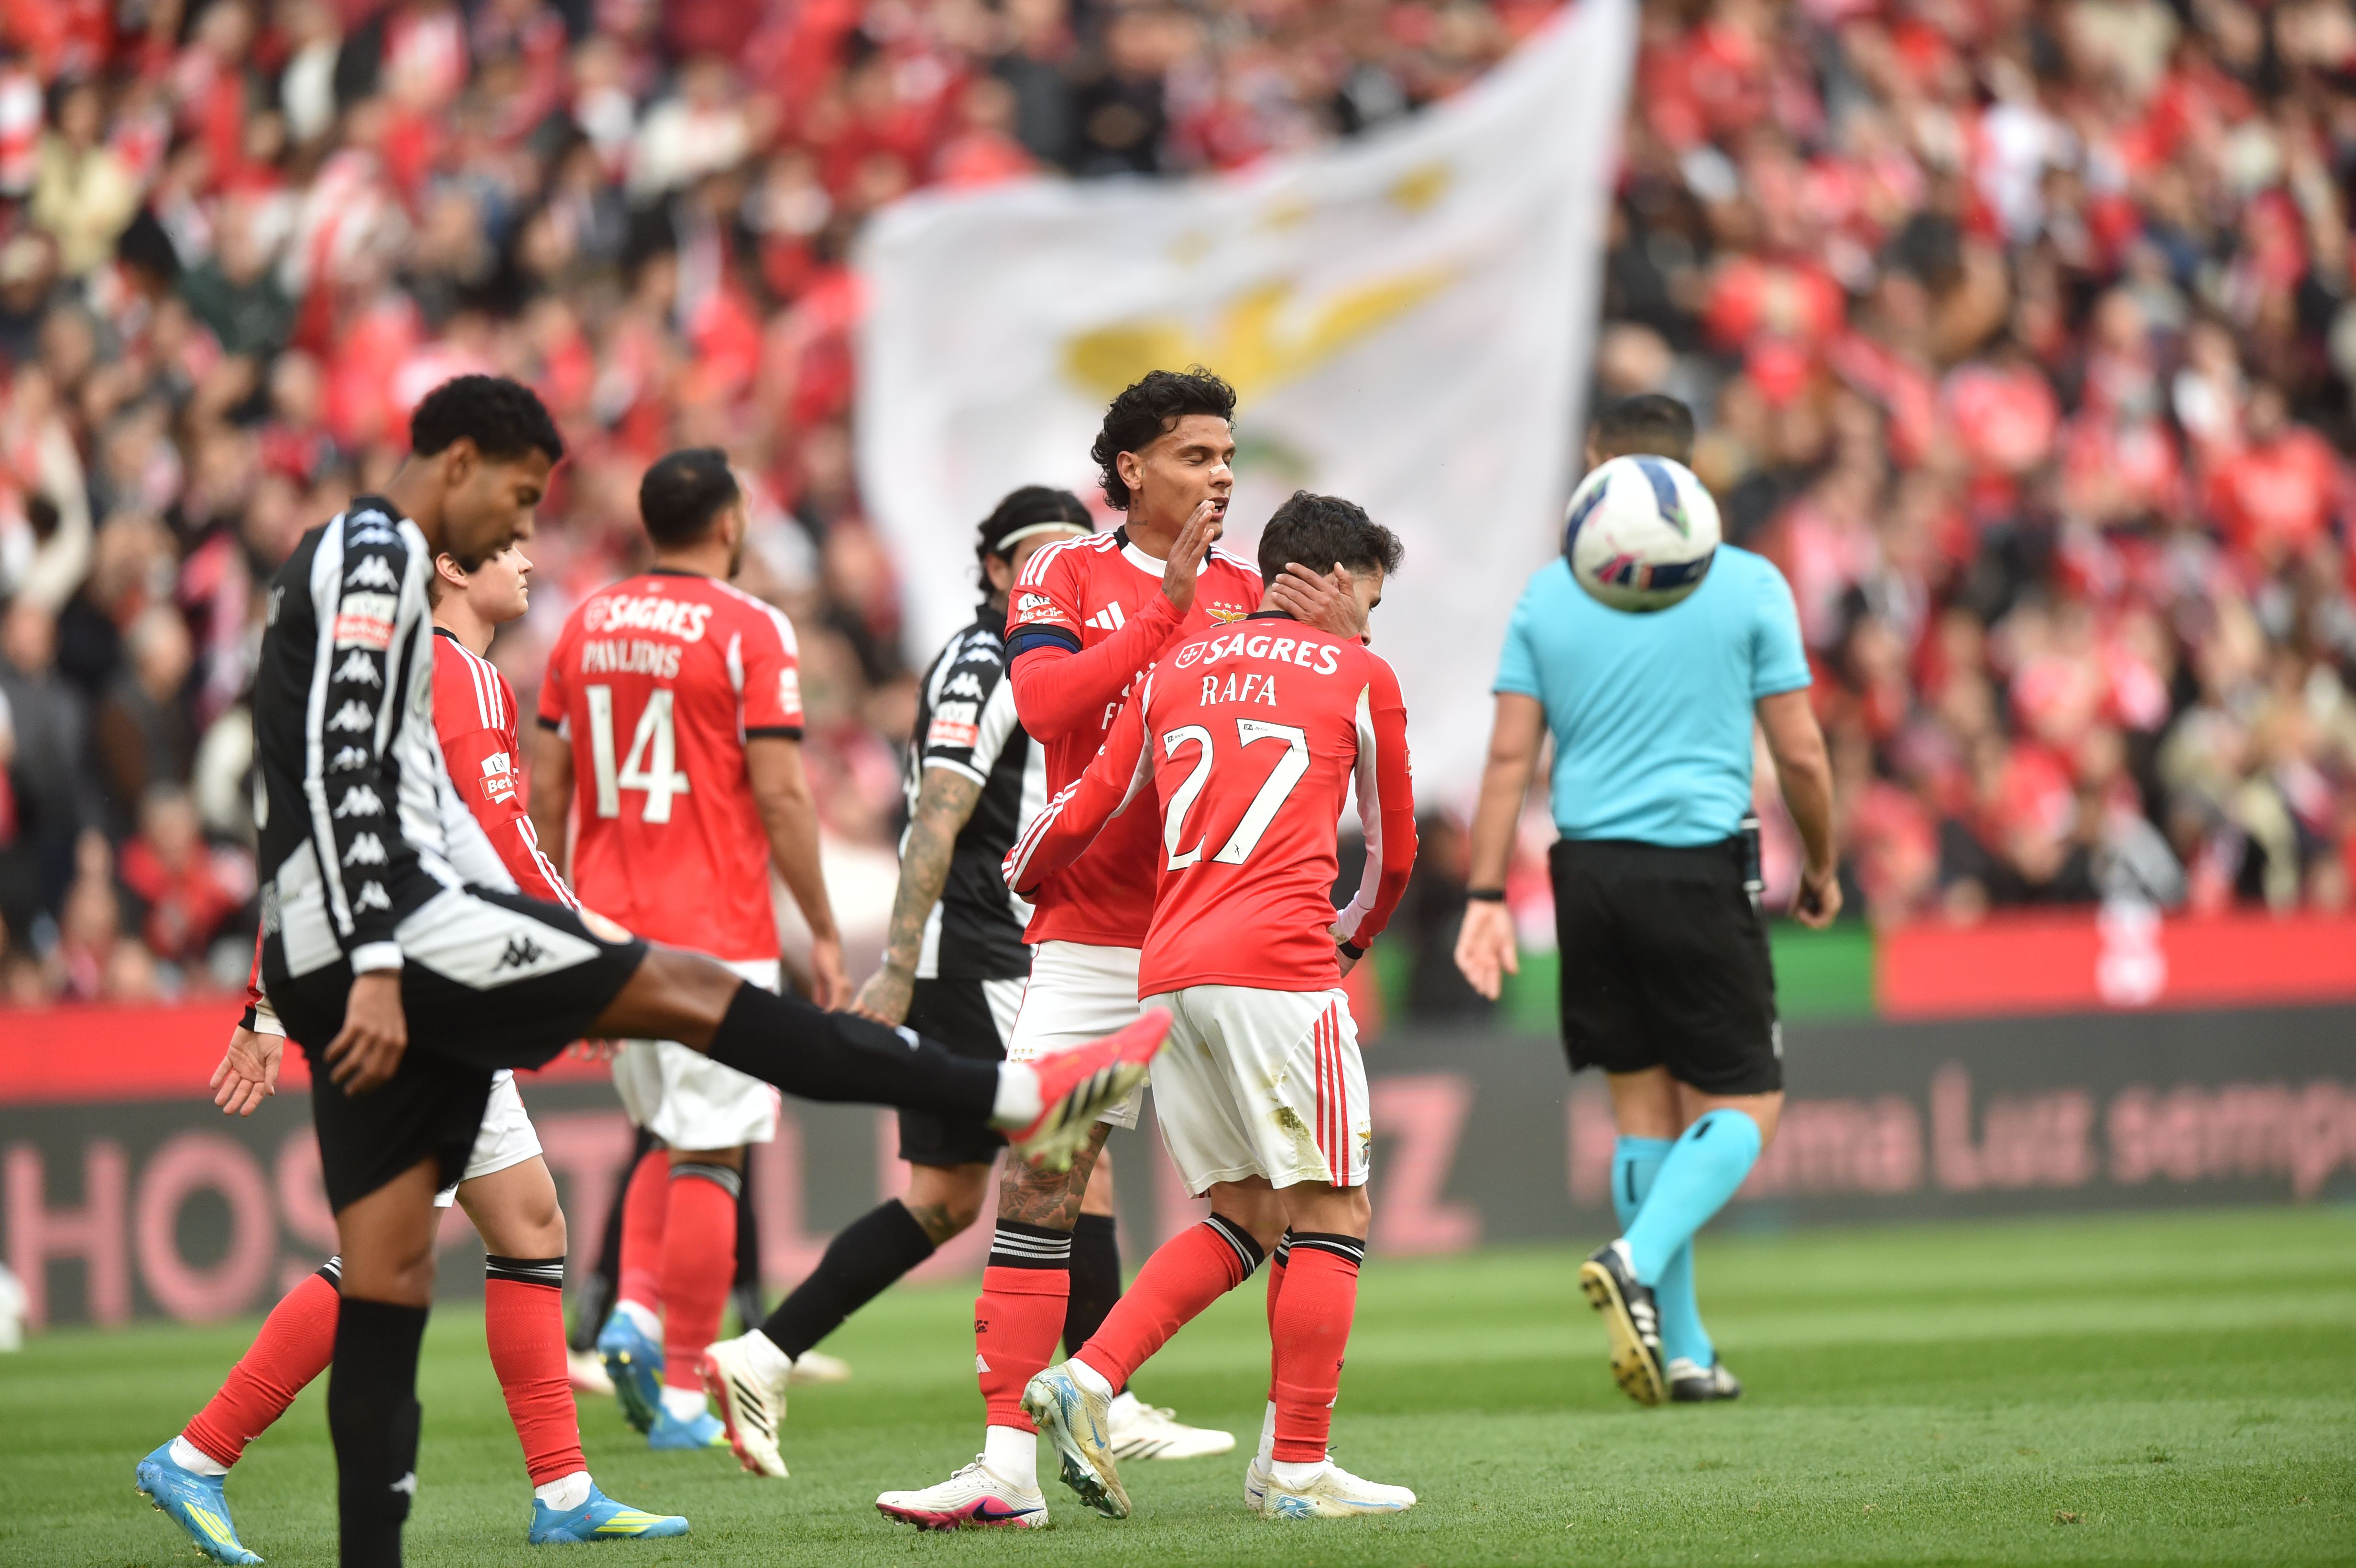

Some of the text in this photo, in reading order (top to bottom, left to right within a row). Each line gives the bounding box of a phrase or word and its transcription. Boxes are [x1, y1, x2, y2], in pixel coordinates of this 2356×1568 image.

[602, 594, 712, 642] SAGRES
[581, 639, 682, 679] PAVLIDIS
[1203, 633, 1341, 675] SAGRES
[1200, 672, 1277, 707] RAFA
[584, 684, 691, 824] 14
[1163, 718, 1311, 871] 27
